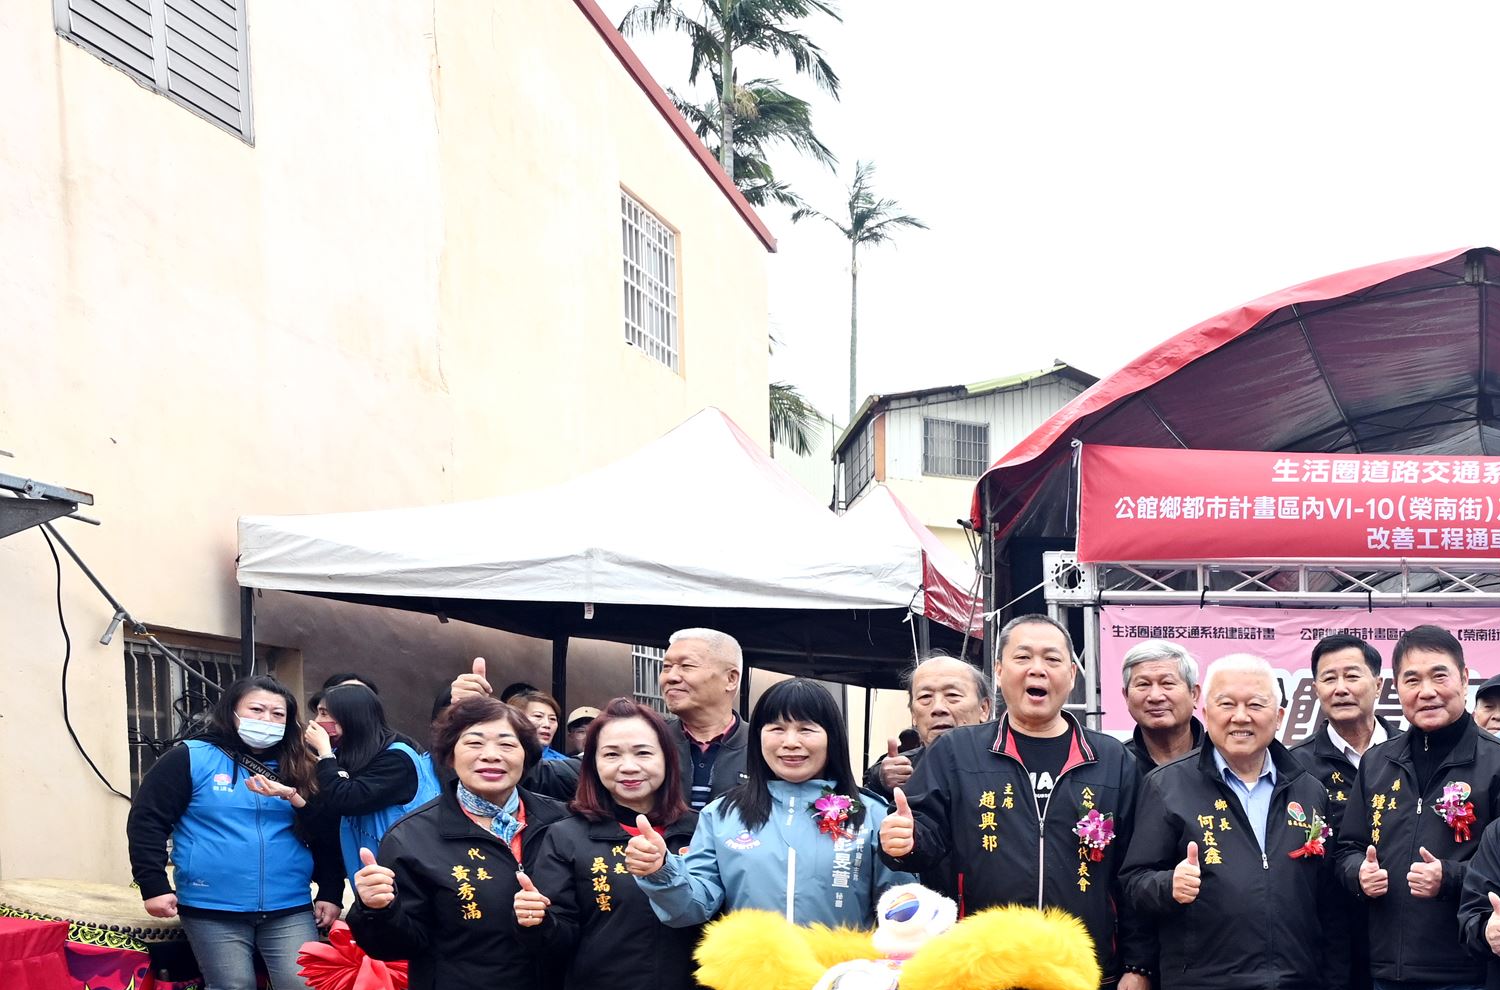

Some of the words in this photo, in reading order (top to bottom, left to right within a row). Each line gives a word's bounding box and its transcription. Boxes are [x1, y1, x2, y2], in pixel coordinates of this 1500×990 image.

[1112, 625, 1276, 641] 生活圈道路交通系統建設計畫
[242, 756, 280, 783] OBINMA
[1002, 783, 1014, 809] 主席
[979, 790, 998, 852] 趙興邦
[1214, 799, 1232, 831] 鄉長
[1197, 814, 1222, 864] 何在鑫
[468, 847, 493, 881] 代表
[612, 845, 628, 874] 代表
[451, 865, 483, 920] 黃秀滿
[591, 857, 612, 912] 吳瑞雲
